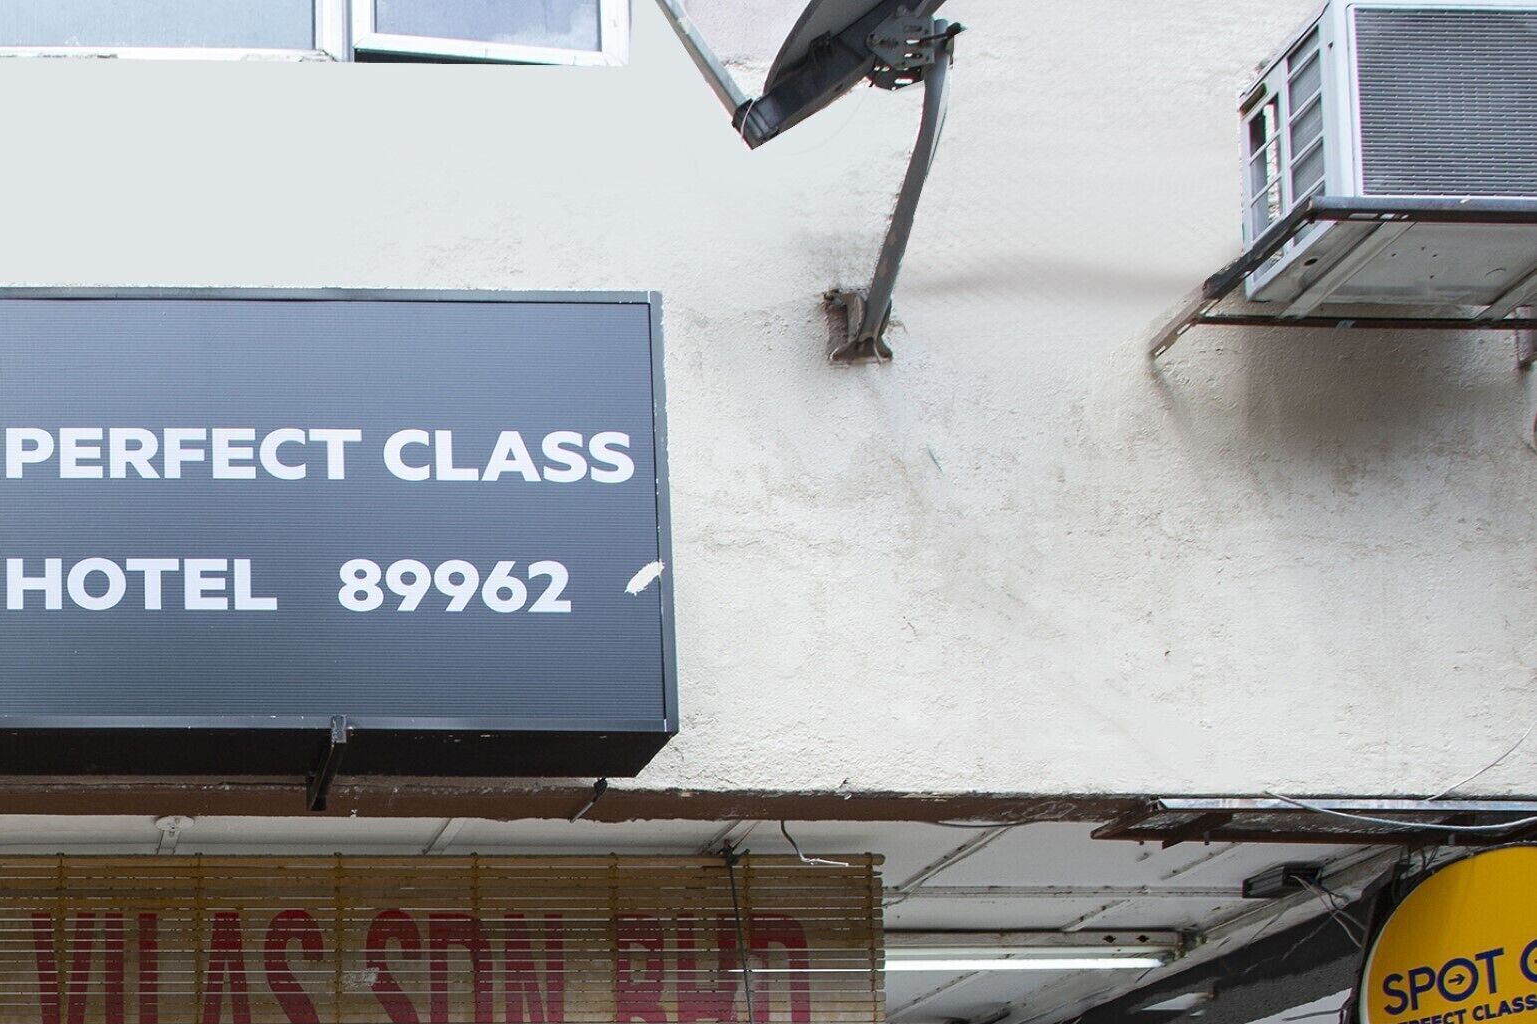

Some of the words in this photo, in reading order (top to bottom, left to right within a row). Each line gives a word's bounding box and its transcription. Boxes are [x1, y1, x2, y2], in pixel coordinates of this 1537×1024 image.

[5, 427, 361, 480] PERFECT
[383, 429, 635, 484] CLASS
[6, 557, 278, 612] HOTEL
[338, 559, 572, 614] 89962
[1382, 947, 1505, 1016] SPOT
[1472, 993, 1537, 1022] CLASS
